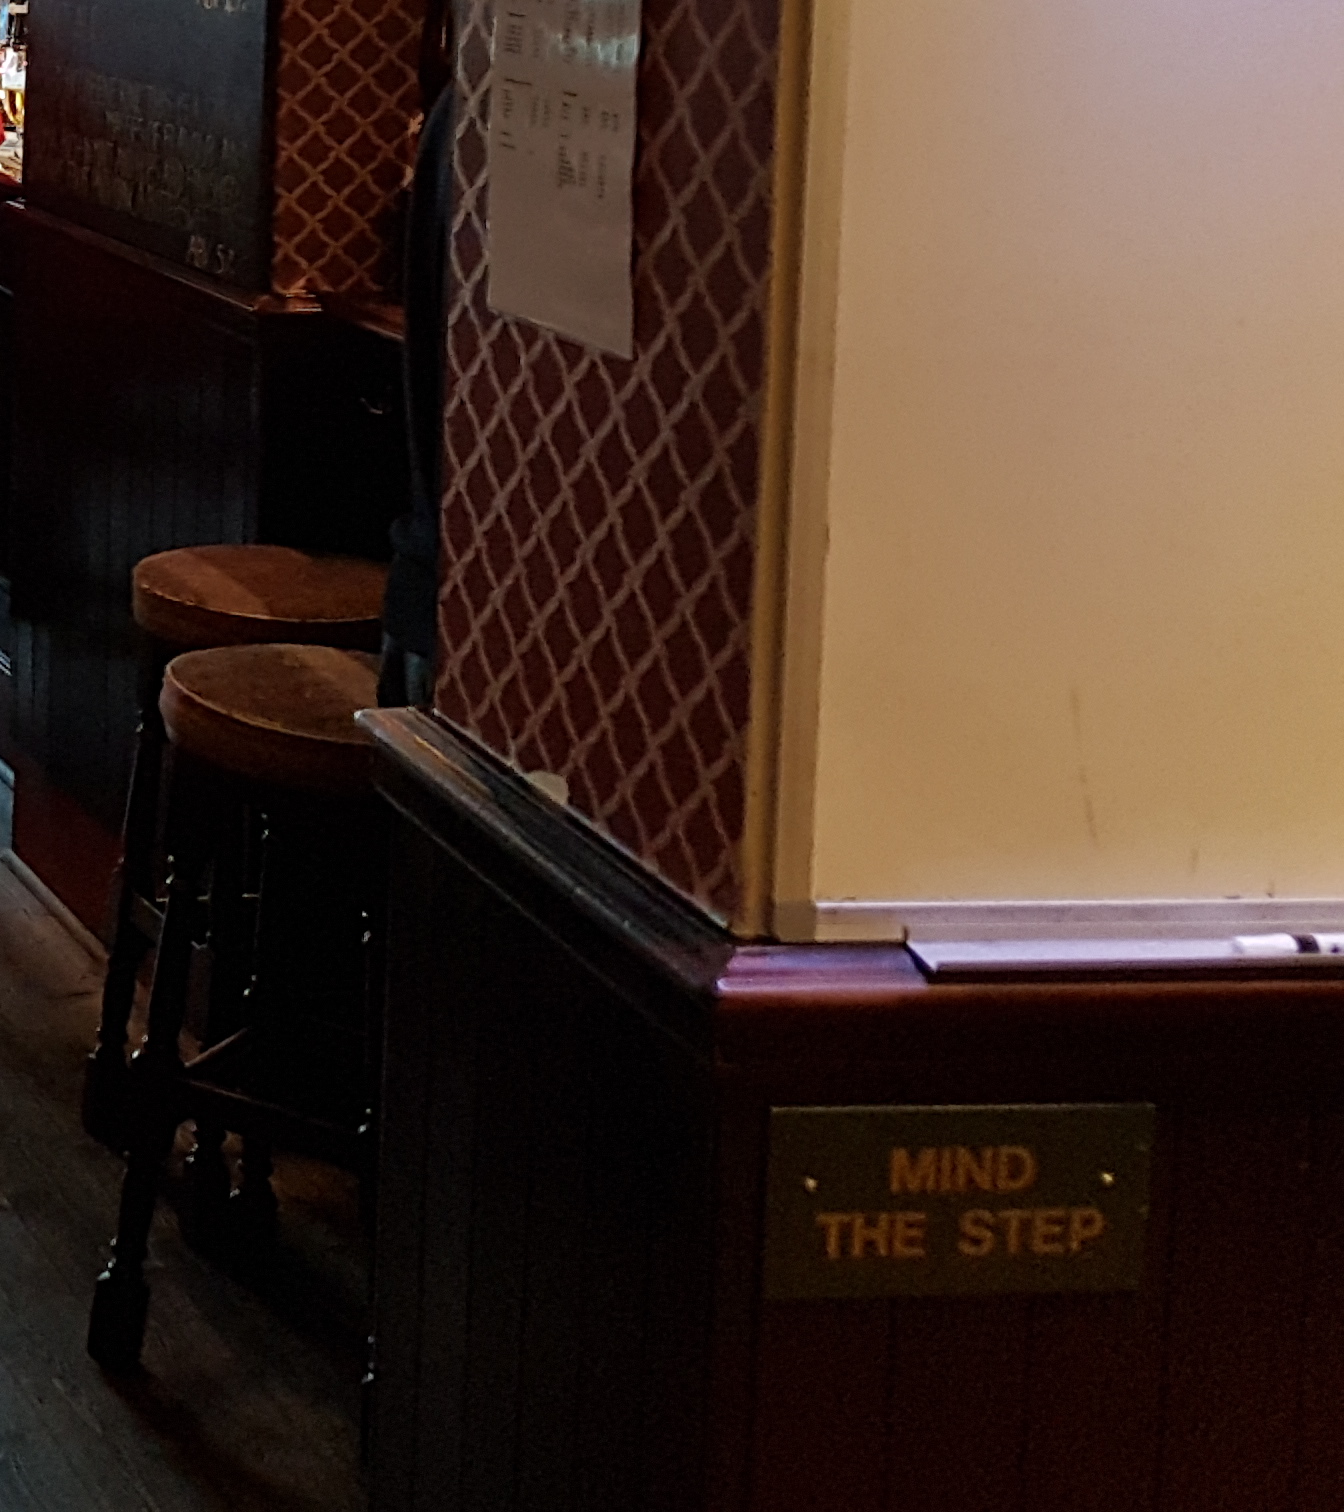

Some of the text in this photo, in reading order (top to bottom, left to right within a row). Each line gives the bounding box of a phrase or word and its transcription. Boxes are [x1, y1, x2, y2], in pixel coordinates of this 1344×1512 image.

[889, 1144, 1037, 1195] MIND
[815, 1206, 1107, 1260] THE STEP
